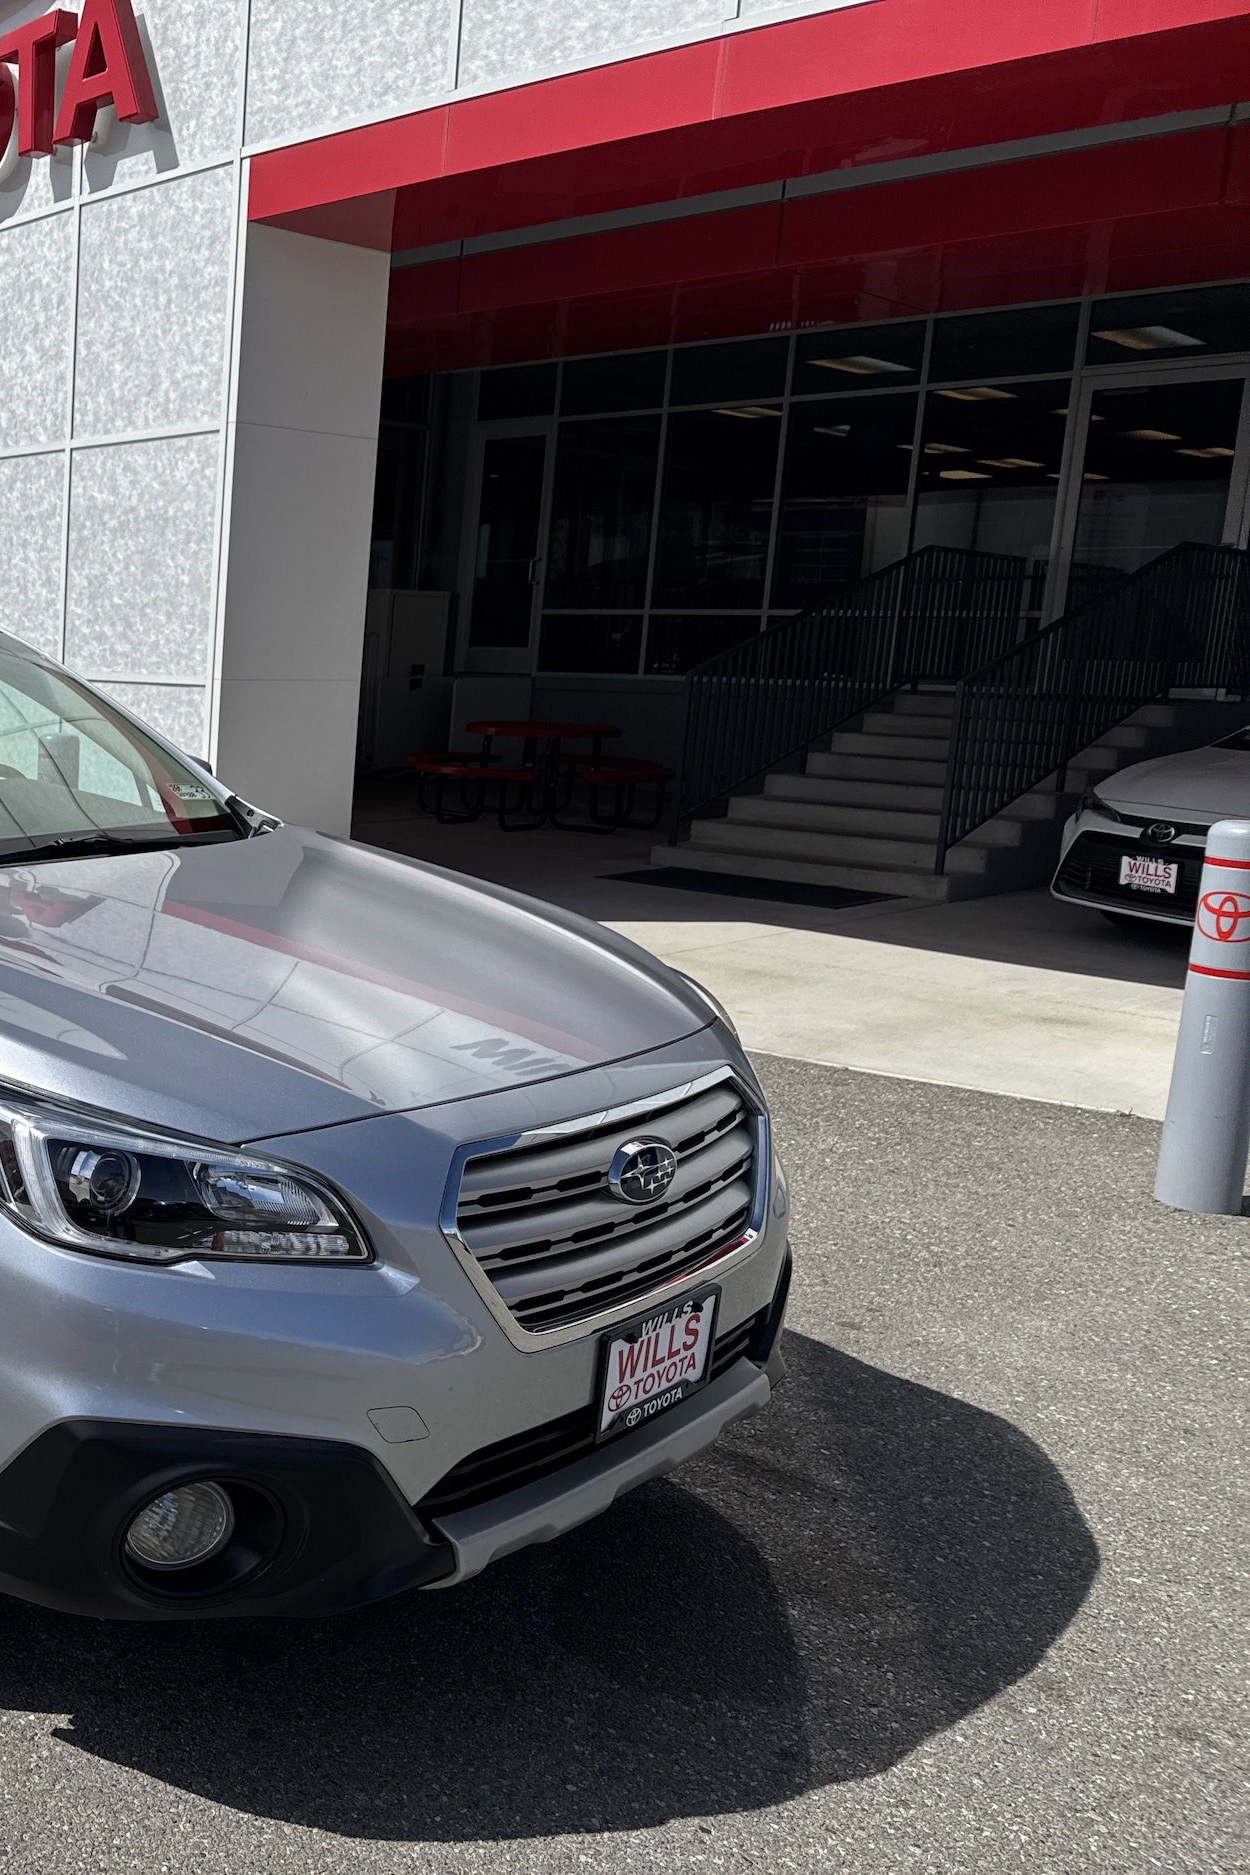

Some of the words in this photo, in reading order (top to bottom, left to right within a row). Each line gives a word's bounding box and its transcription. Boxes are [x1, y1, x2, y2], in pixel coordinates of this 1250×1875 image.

[1128, 861, 1172, 879] WILLS
[1137, 875, 1172, 888] TOYOTA
[641, 1300, 694, 1337] WILLS
[618, 1313, 701, 1384] WILLS
[633, 1352, 697, 1400] TOYOTA
[643, 1386, 683, 1418] TOYOTA
